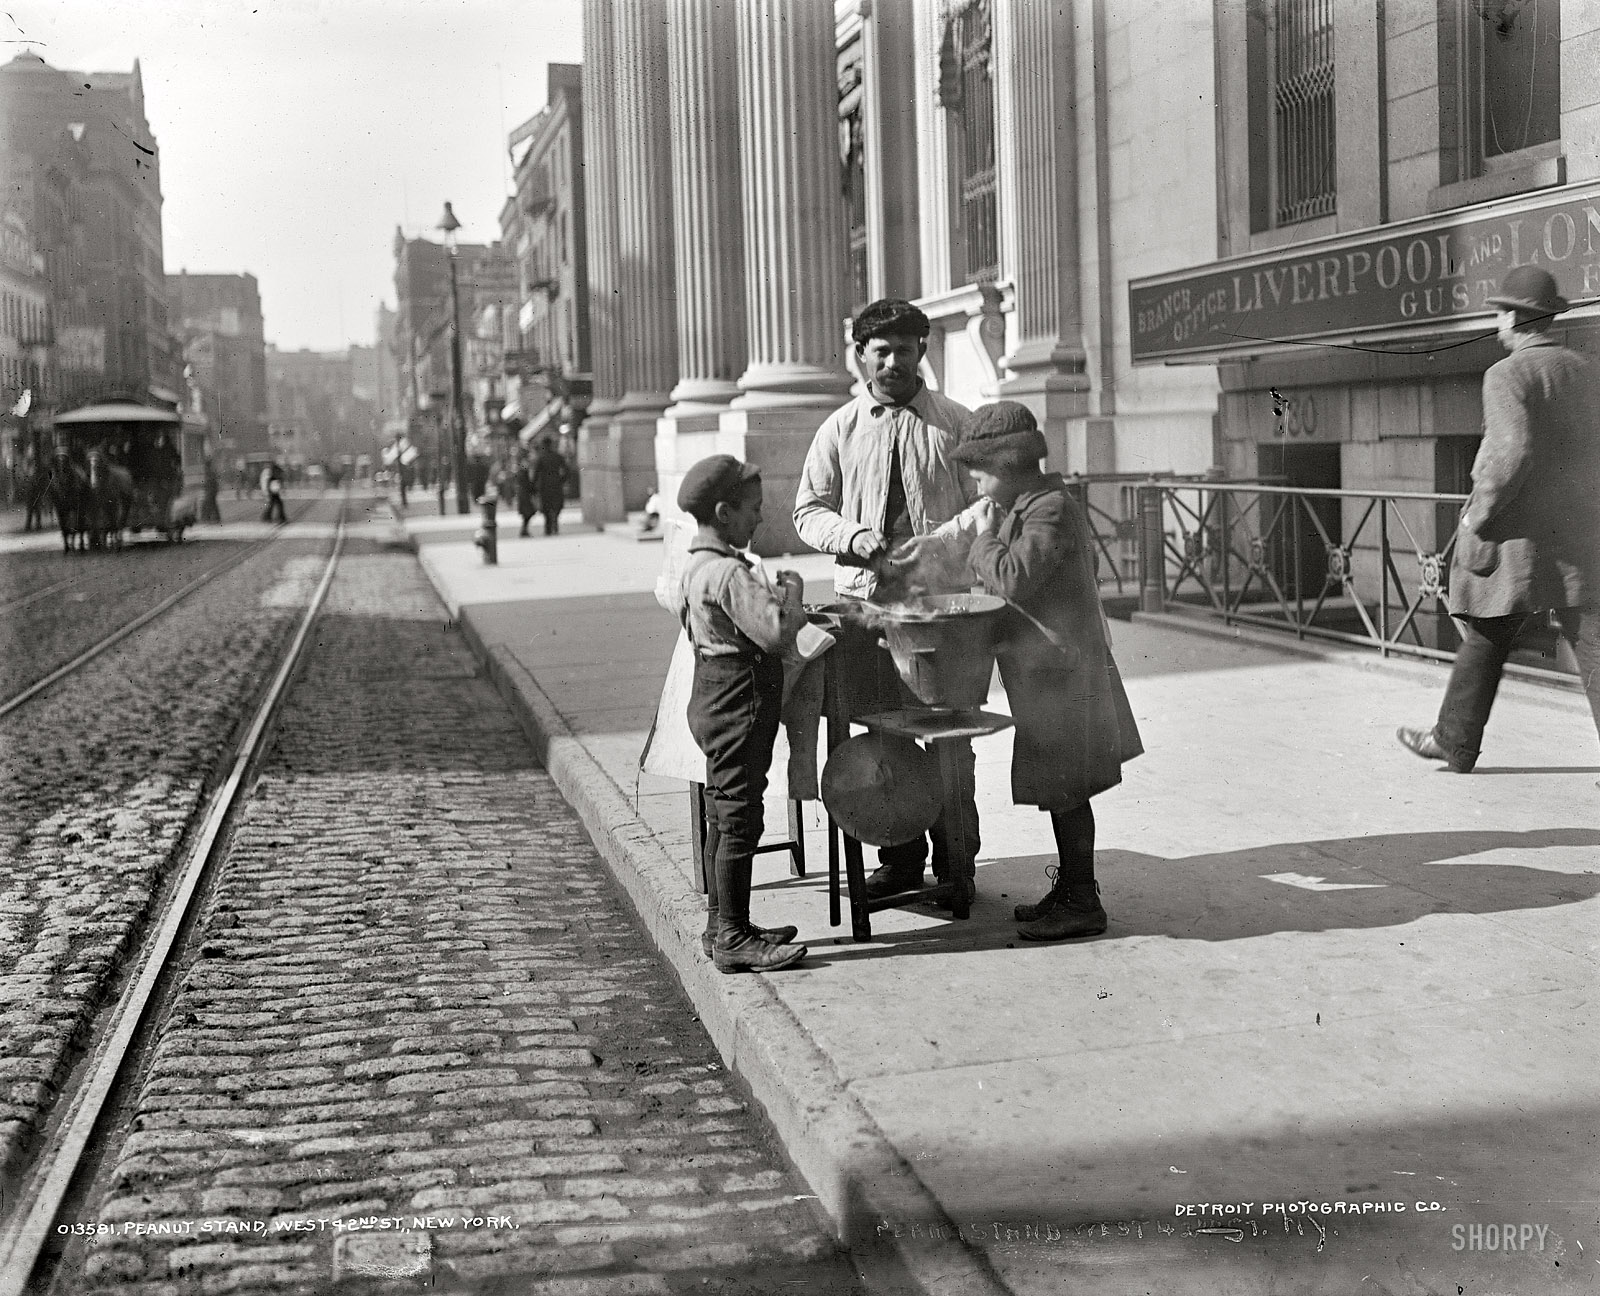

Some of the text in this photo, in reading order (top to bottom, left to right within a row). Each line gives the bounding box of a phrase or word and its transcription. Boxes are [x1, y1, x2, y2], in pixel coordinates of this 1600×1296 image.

[1232, 235, 1466, 313] LIVERPOOL
[1470, 234, 1502, 266] AND
[1138, 288, 1191, 333] BRANCH
[1174, 288, 1227, 342] OFFICE
